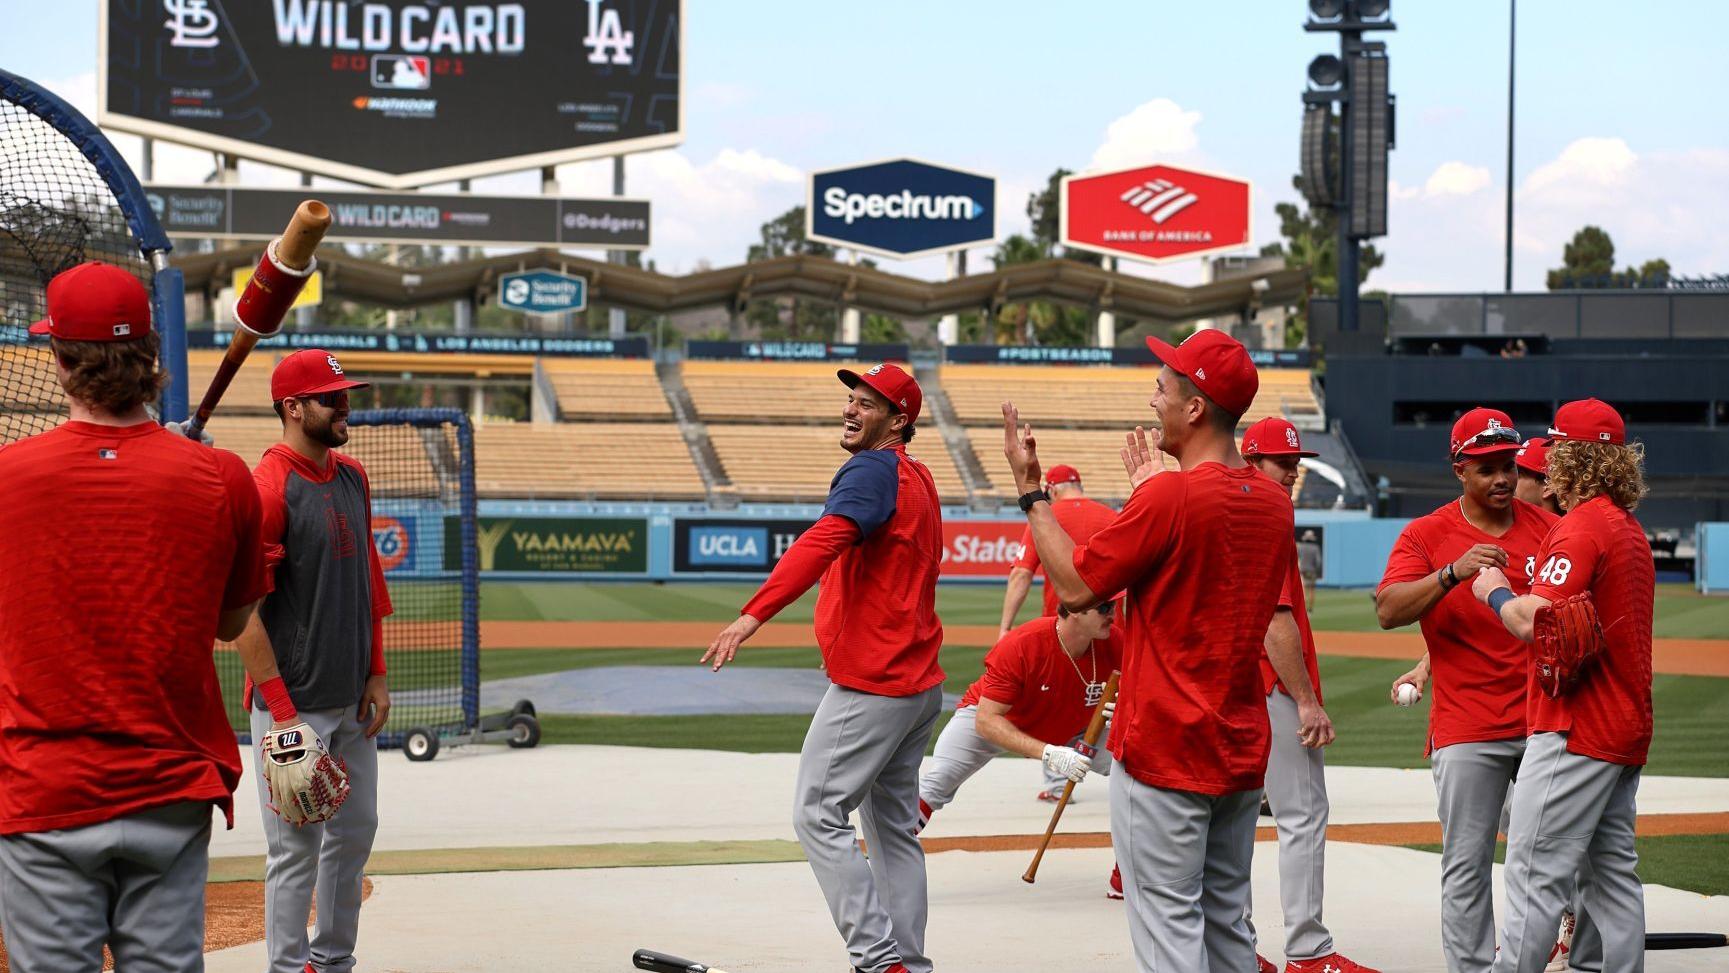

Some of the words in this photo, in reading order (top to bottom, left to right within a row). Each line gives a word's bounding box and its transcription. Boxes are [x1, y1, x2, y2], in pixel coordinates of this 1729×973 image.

[272, 0, 392, 50] WILD
[400, 4, 525, 53] CARD
[337, 203, 386, 227] WILD
[387, 205, 440, 228] CARD
[824, 187, 974, 225] Spectrum
[563, 212, 646, 233] @Dodgers
[1103, 230, 1136, 241] BANK
[1139, 230, 1155, 241] OF
[1157, 230, 1212, 242] AMERICA
[531, 279, 577, 295] Security
[290, 334, 378, 348] CARDINALS
[436, 337, 467, 350] LOS
[999, 347, 1113, 361] #POSTSEASON
[700, 534, 759, 557] UCLA
[952, 534, 1019, 563] State
[1539, 555, 1572, 586] 48
